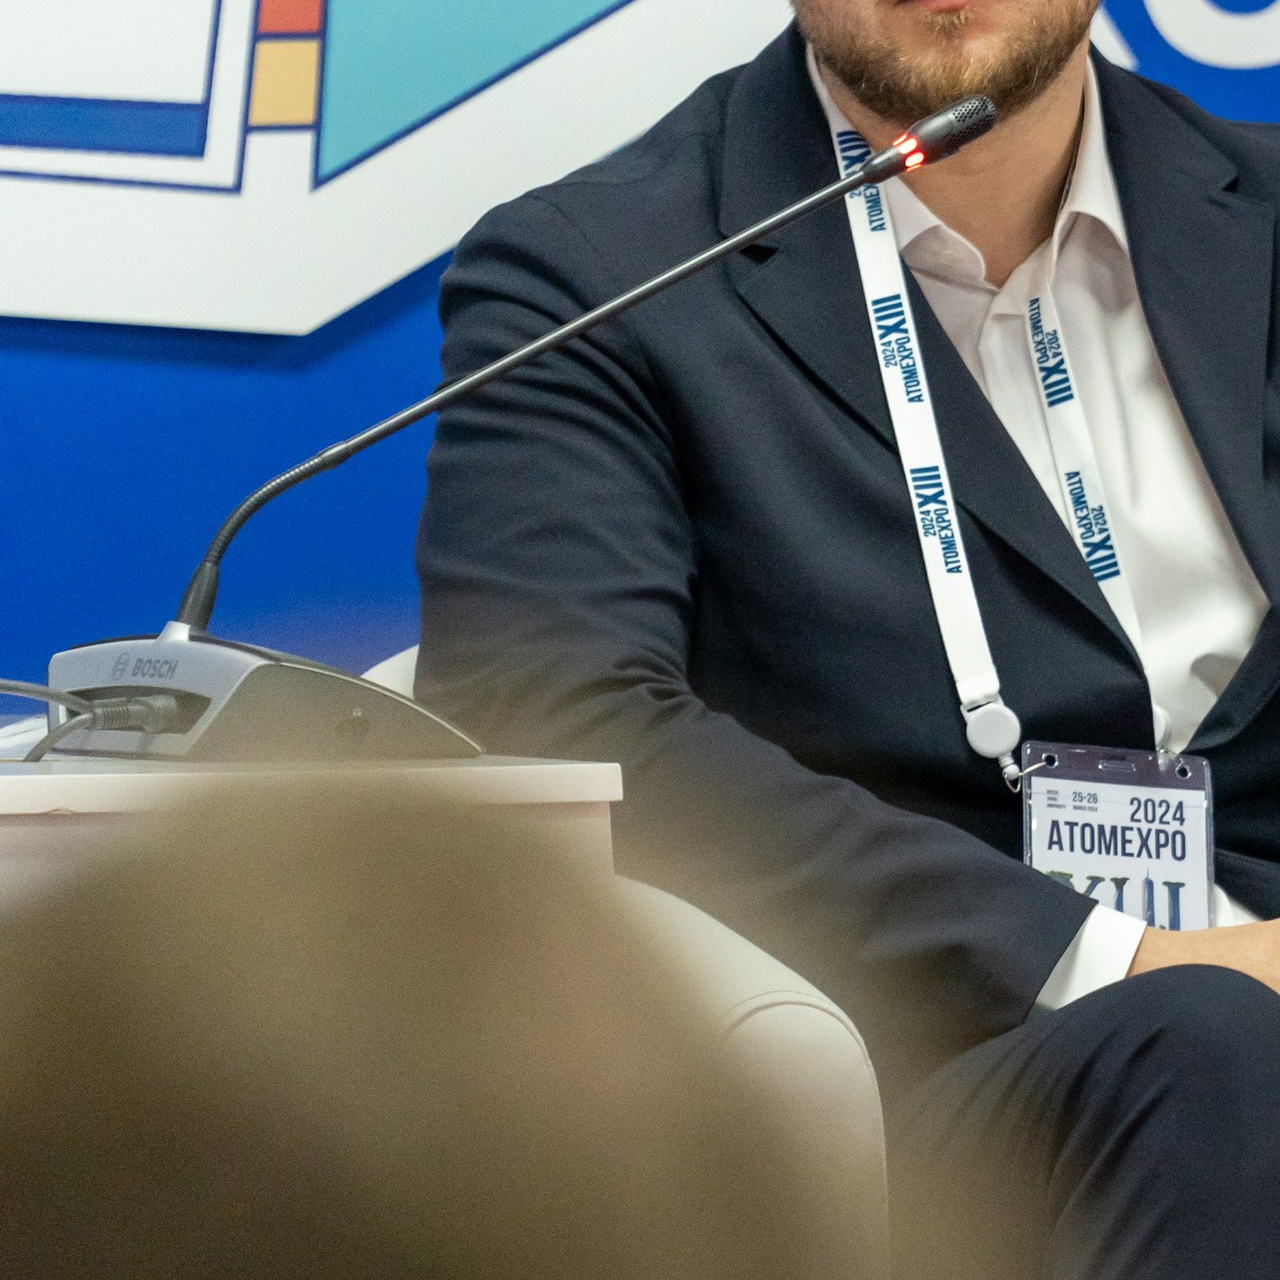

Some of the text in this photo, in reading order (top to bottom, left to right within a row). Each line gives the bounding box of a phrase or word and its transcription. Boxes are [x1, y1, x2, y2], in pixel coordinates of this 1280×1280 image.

[863, 183, 887, 232] ATOMEX
[871, 293, 909, 341] XIII
[1028, 297, 1050, 365] ATOMEXPO
[880, 340, 898, 369] 2024
[1045, 329, 1062, 360] 2024
[895, 335, 925, 404] ATOMEXPO
[1038, 357, 1075, 408] XIII
[909, 465, 948, 509] XIII
[1064, 470, 1095, 540] ATOMEXPO
[919, 509, 937, 538] 2024
[933, 507, 963, 574] ATOMEXPO
[1091, 505, 1109, 535] 2024
[1082, 534, 1121, 583] XIII
[131, 658, 179, 679] BOSCH
[1072, 791, 1099, 805] 25-26
[1129, 796, 1186, 827] 2024
[1047, 819, 1187, 862] ATOMEXPO
